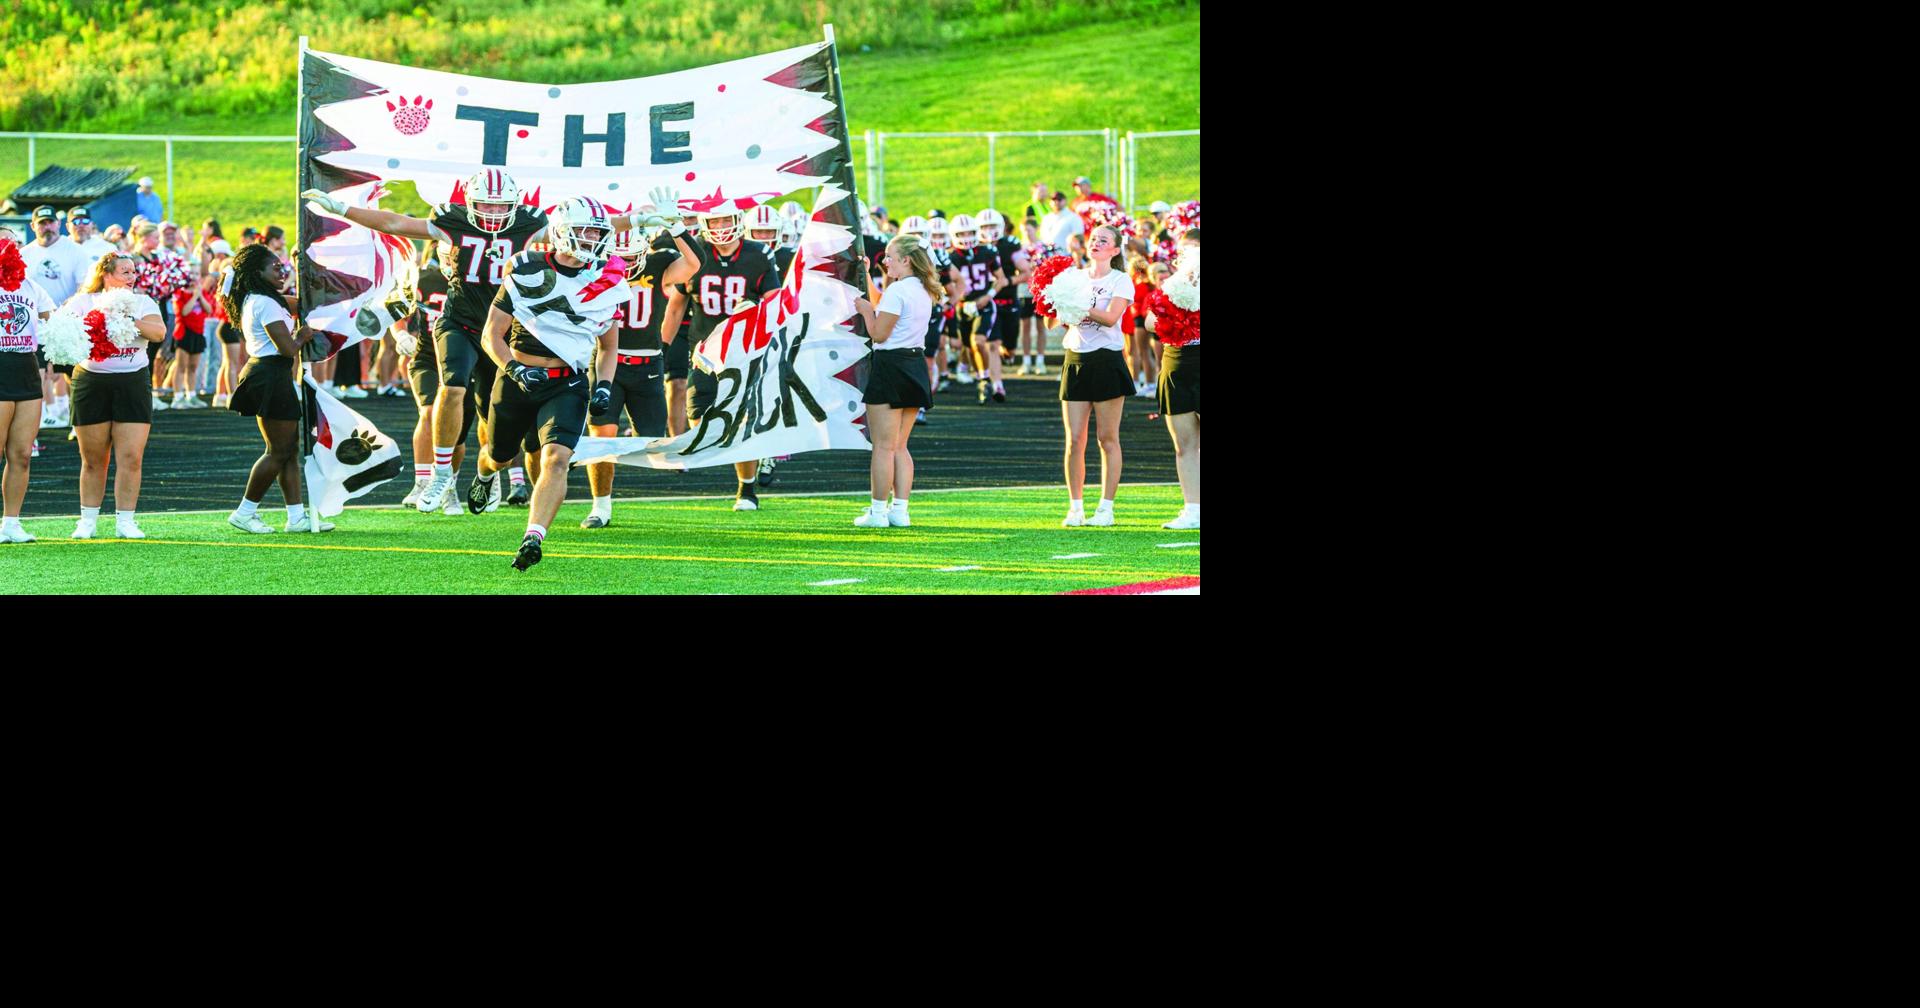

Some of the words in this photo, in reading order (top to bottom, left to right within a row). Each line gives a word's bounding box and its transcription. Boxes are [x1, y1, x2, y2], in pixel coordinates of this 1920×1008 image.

[455, 100, 694, 168] THE
[460, 235, 513, 285] 78
[700, 274, 747, 317] 68
[678, 312, 828, 456] BACK
